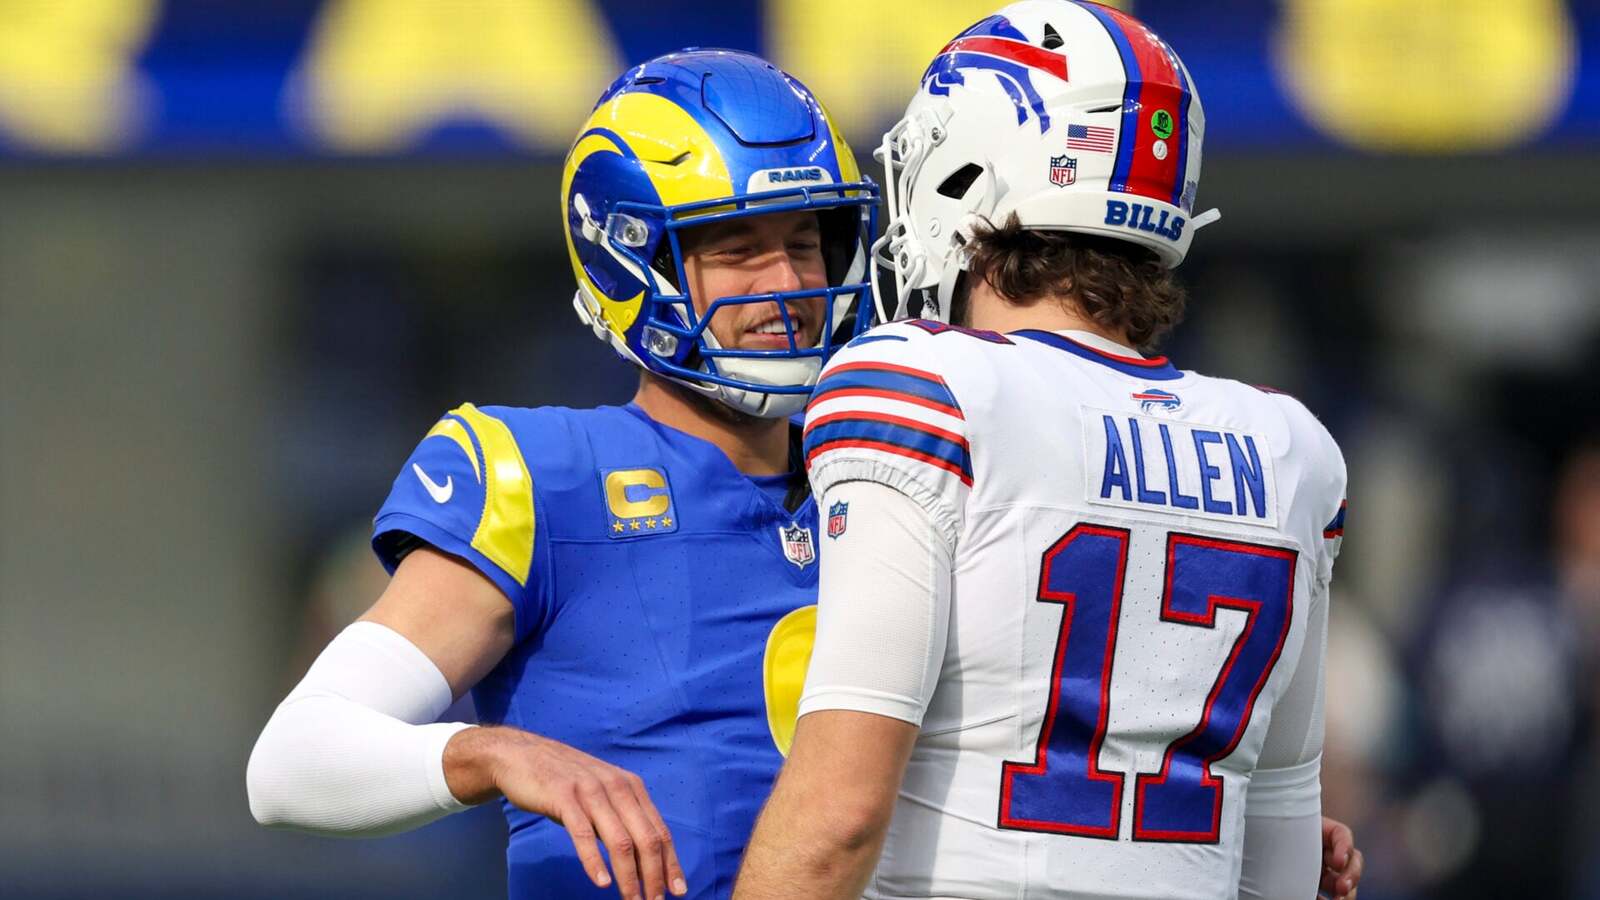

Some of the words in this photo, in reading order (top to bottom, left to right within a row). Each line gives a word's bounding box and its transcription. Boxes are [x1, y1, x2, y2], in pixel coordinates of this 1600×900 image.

[768, 169, 822, 183] RAMS
[1051, 168, 1074, 184] NFL
[1104, 200, 1186, 242] BILLS
[1100, 414, 1267, 519] ALLEN
[605, 468, 670, 519] C
[997, 521, 1300, 845] 17
